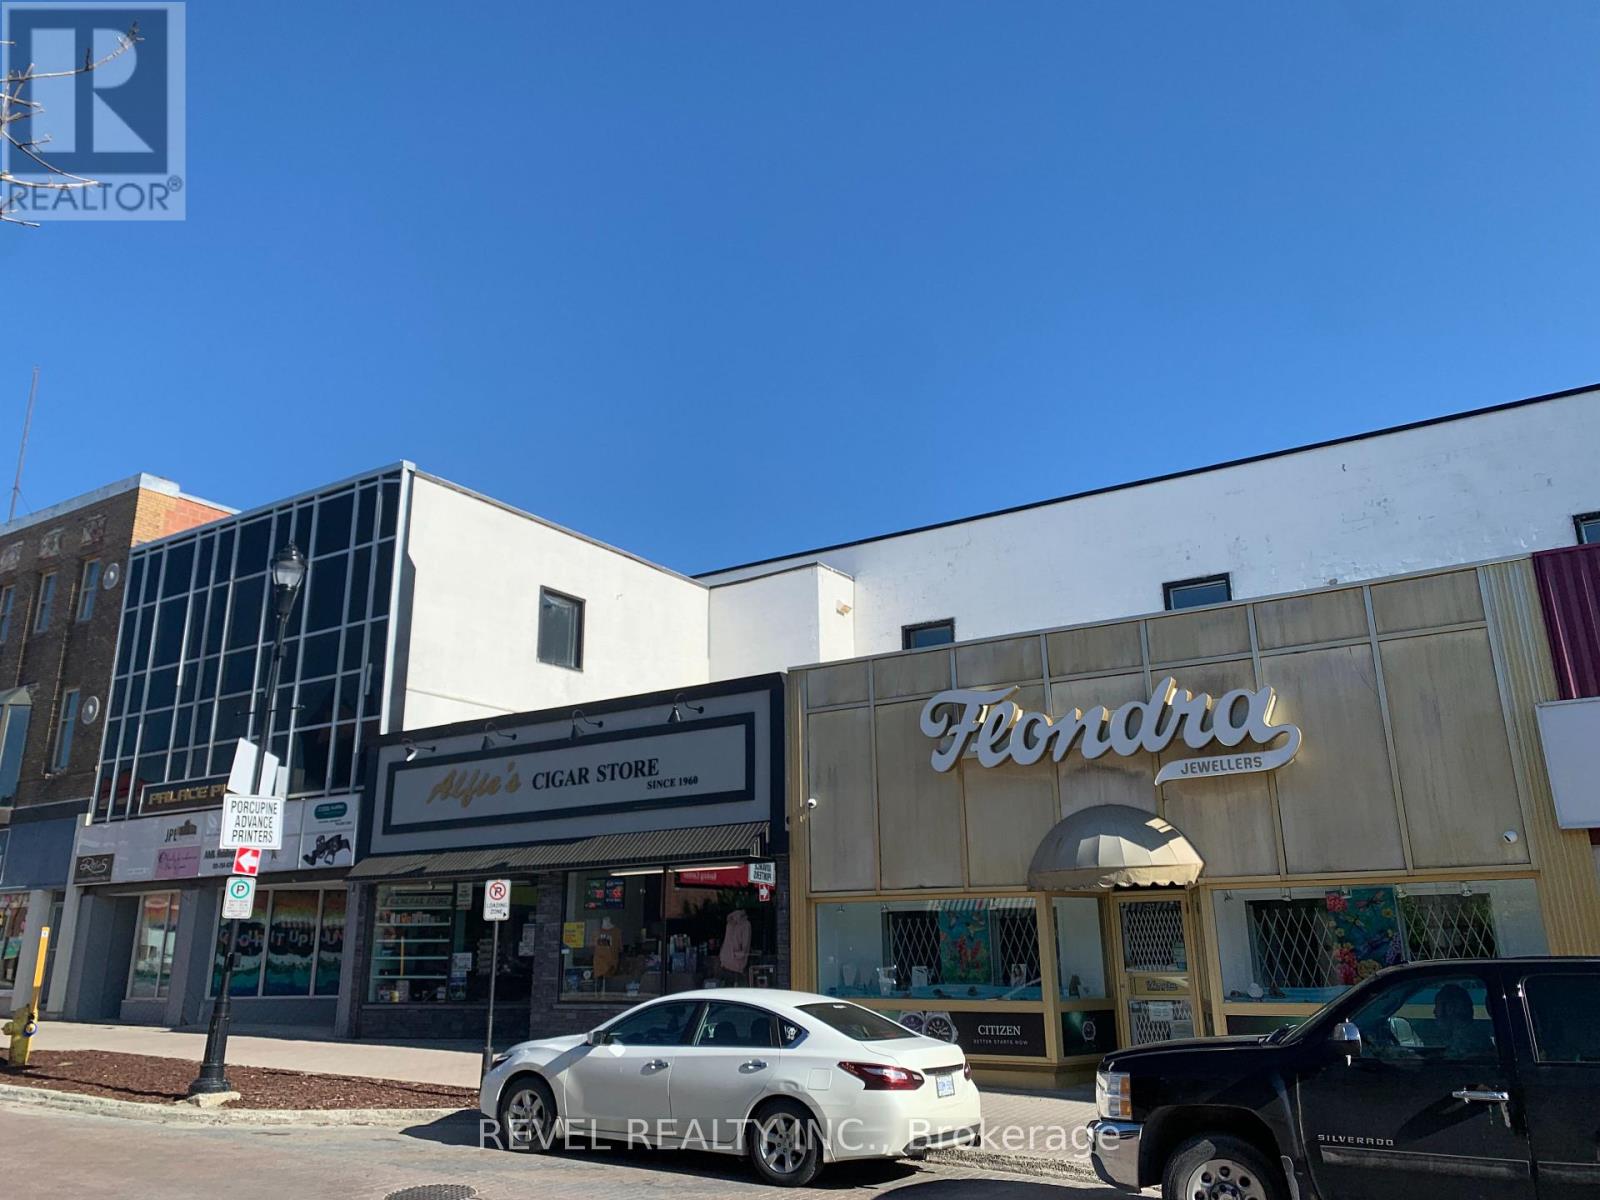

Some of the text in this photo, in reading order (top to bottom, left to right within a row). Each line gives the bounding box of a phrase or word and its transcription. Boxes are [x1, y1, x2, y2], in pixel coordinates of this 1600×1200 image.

[919, 676, 1301, 774] Flondra
[1180, 756, 1263, 775] JEWELLERS
[426, 758, 660, 808] Alfie's CIGAR STORE
[647, 775, 699, 790] SINCE 1960
[148, 785, 209, 806] PALACE
[230, 800, 278, 815] PORCUPINE
[234, 815, 273, 829] ADVANCE
[231, 829, 273, 843] PRINTERS
[977, 1024, 1022, 1037] CITIZEN
[1317, 1134, 1395, 1147] SILVERADO
